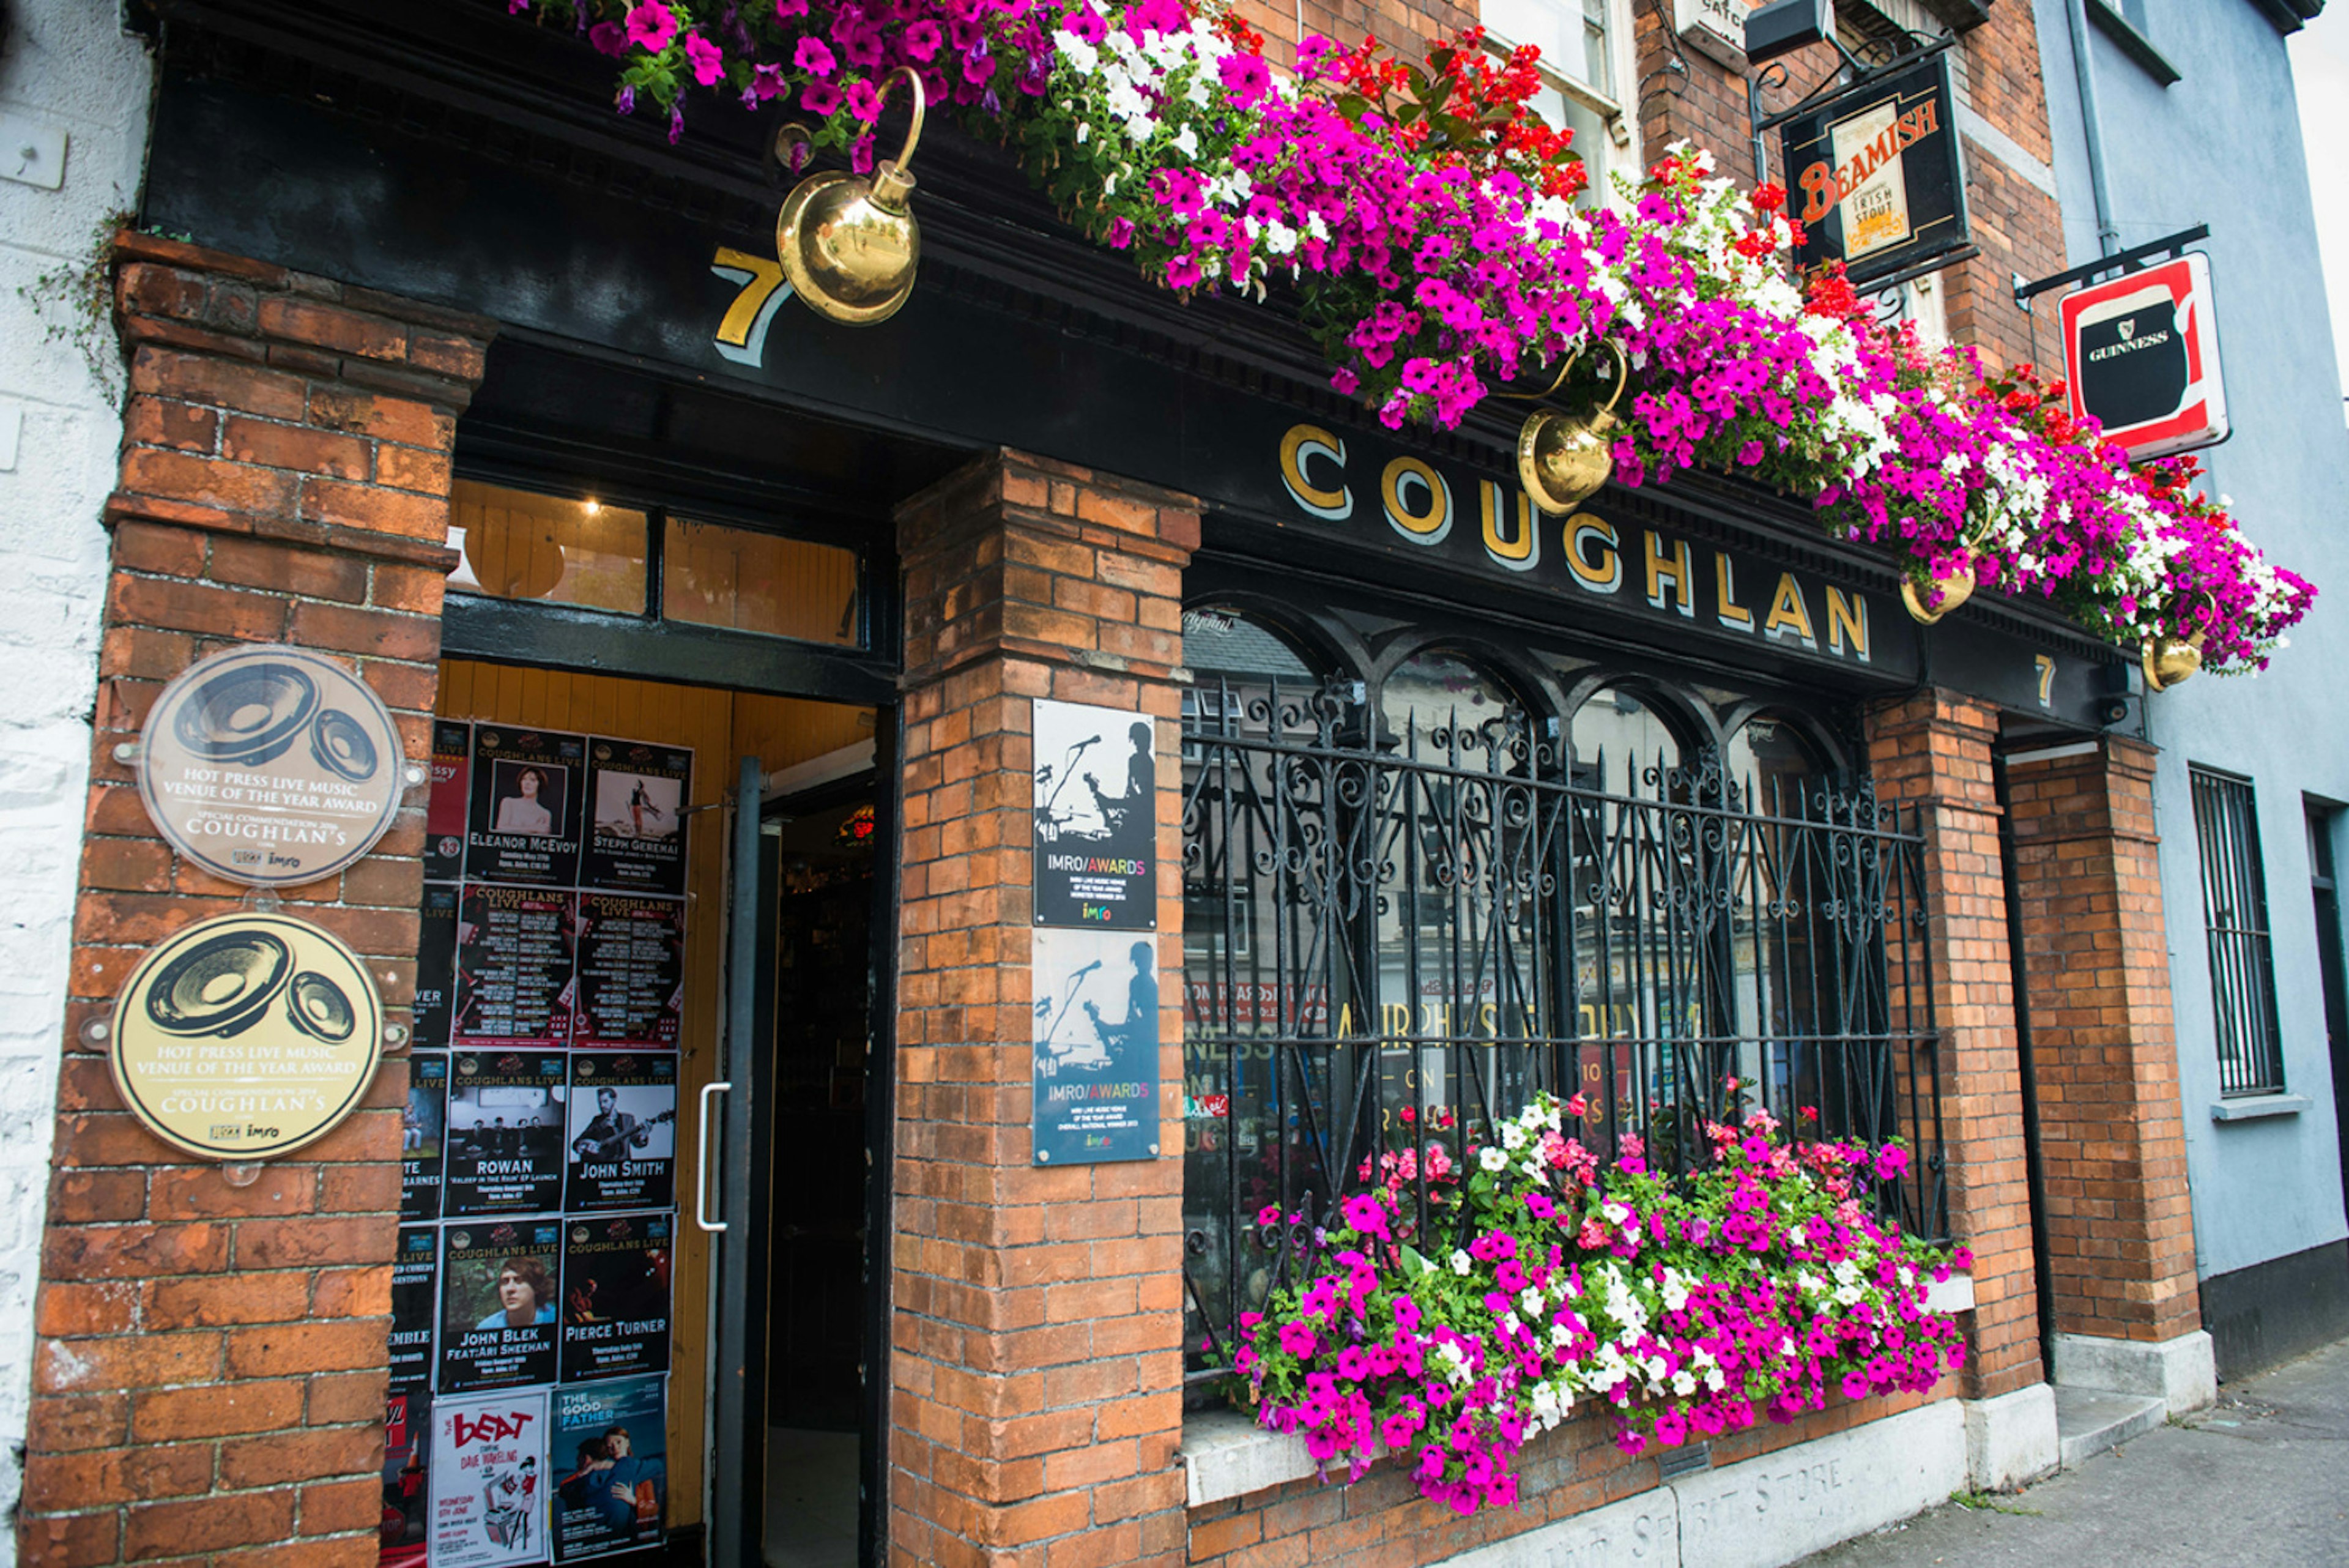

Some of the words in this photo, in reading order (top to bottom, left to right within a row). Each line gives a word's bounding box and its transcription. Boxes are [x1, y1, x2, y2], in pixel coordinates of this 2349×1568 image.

[1799, 98, 1940, 228] BEAMISH
[1854, 188, 1892, 211] IRISH
[1855, 201, 1892, 225] STOUT
[710, 246, 794, 368] 7
[2089, 329, 2169, 362] GUINNESS
[1279, 423, 1871, 663] COUGHLAN
[2035, 653, 2057, 707] 7
[478, 748, 552, 764] COUGHLANS
[554, 756, 582, 767] LIVE
[184, 768, 221, 783] HOT
[224, 771, 268, 788] PRESS
[273, 776, 305, 792] LIVE
[309, 781, 360, 797] MUSIC
[163, 781, 217, 798] VENUE
[221, 787, 244, 800] OF
[247, 789, 279, 804] THE
[283, 793, 321, 808] YEAR
[322, 798, 377, 814] AWARD
[187, 819, 347, 845] COUGHLAN'S
[470, 832, 526, 850] ELEANOR
[593, 835, 629, 849] STEPH
[267, 852, 300, 869] imro
[476, 887, 564, 904] COUGHLANS
[489, 897, 519, 910] LIVE
[591, 896, 673, 912] COUGHLANS
[601, 907, 630, 917] LIVE
[1082, 902, 1111, 921] imro
[157, 1046, 194, 1060] HOT
[198, 1046, 243, 1060] PRESS
[247, 1046, 281, 1060] LIVE
[285, 1046, 336, 1060] MUSIC
[136, 1061, 192, 1076] VENUE
[196, 1061, 218, 1076] OF
[223, 1061, 254, 1075] THE
[258, 1061, 296, 1075] YEAR
[300, 1060, 357, 1075] AWARD
[415, 1078, 445, 1090] LIVE
[455, 1076, 532, 1087] COUGHLANS
[535, 1075, 563, 1086] LIVE
[574, 1076, 645, 1087] COUGHLANS
[647, 1076, 674, 1086] LIVE
[161, 1096, 326, 1113] COUGHLAN'S
[247, 1124, 280, 1138] imro
[477, 1159, 533, 1175] ROWAN
[579, 1163, 618, 1180] JOHN
[622, 1160, 665, 1177] SMITH
[448, 1246, 526, 1260] COUGHLANS
[529, 1243, 557, 1253] LIVE
[568, 1240, 640, 1254] COUGHLANS
[642, 1238, 669, 1248] LIVE
[460, 1332, 499, 1347] JOHN
[503, 1328, 539, 1343] BLEK
[566, 1325, 613, 1342] PIERCE
[616, 1318, 666, 1336] TURNER
[500, 1341, 551, 1355] SHEEHAN
[562, 1392, 588, 1405] THE
[562, 1401, 601, 1416] GOOD
[562, 1409, 615, 1427] FATHER
[461, 1454, 480, 1470] DAVE
[482, 1449, 518, 1465] WAKELING
[439, 1495, 475, 1506] WEDNESDAY
